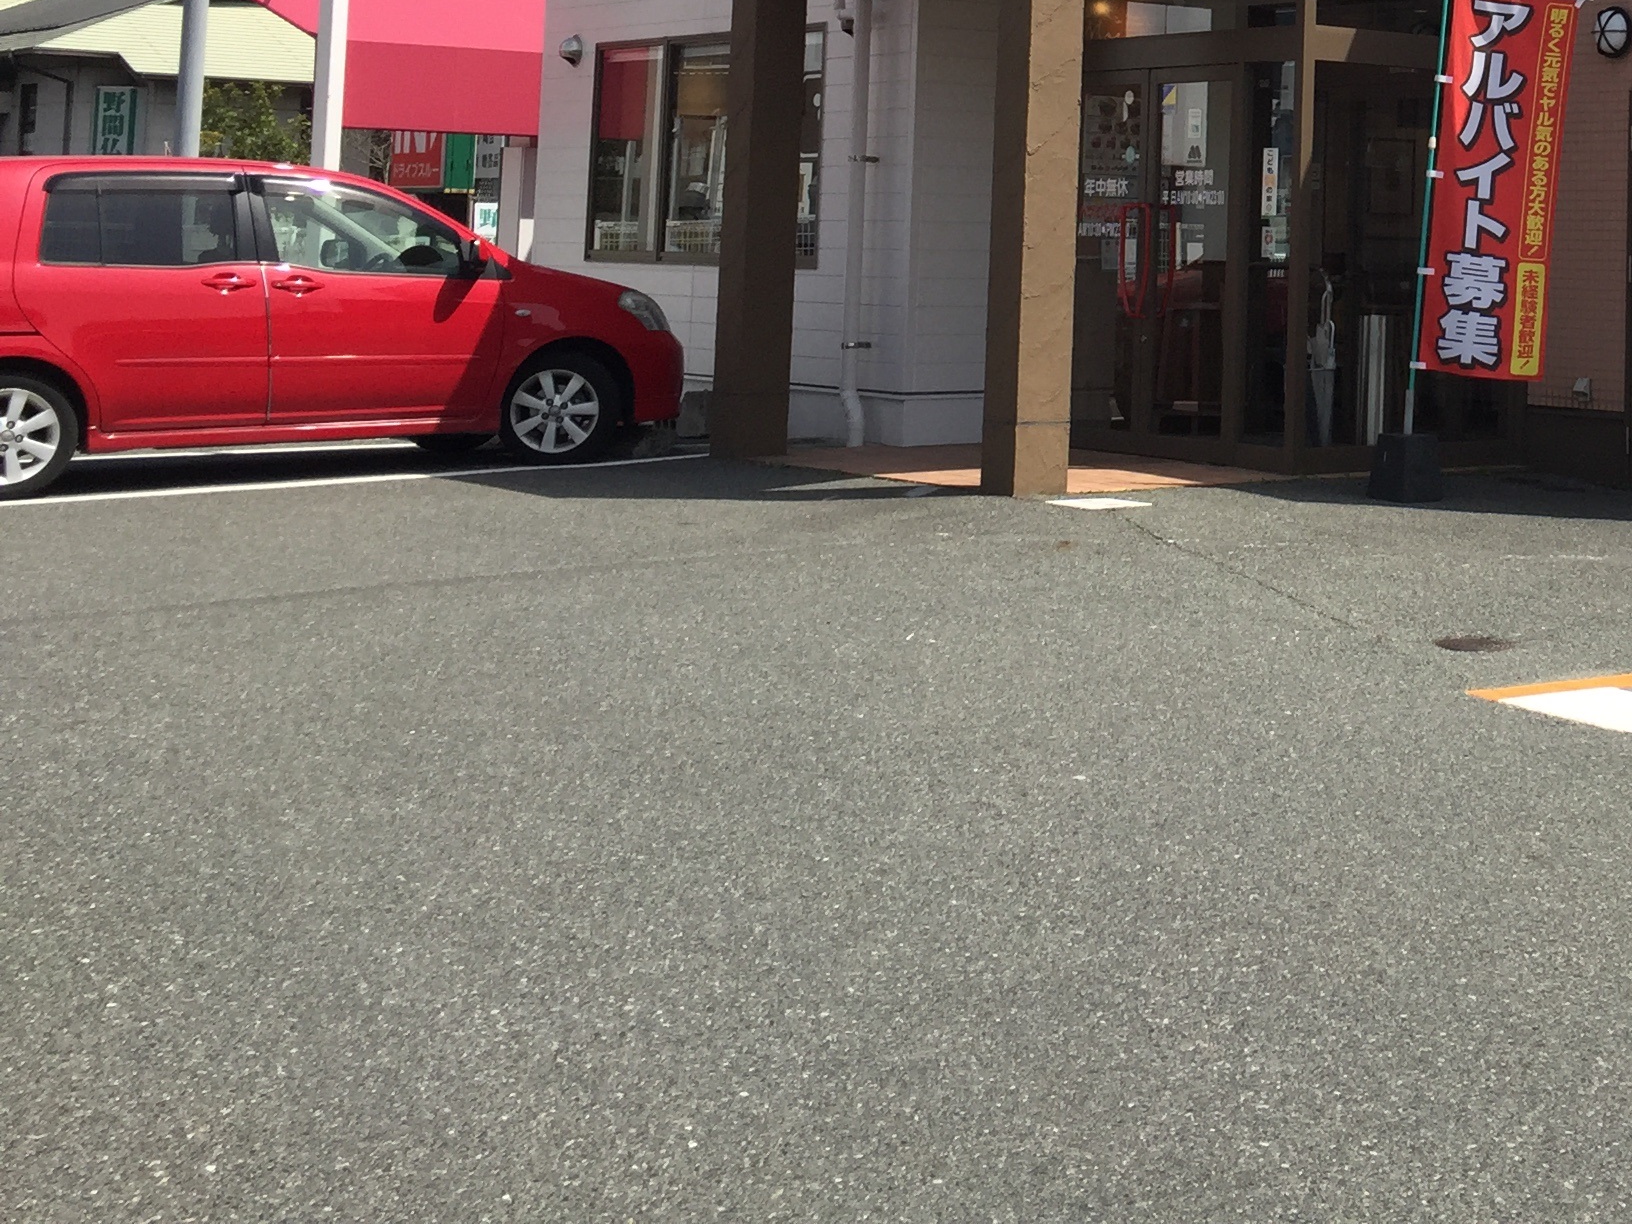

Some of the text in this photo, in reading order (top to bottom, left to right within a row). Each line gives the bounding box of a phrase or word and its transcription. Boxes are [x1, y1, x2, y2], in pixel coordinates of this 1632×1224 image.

[392, 162, 439, 178] ドライブスルー
[1084, 178, 1129, 197] 年中無休
[1437, 0, 1532, 367] アルバイト募集
